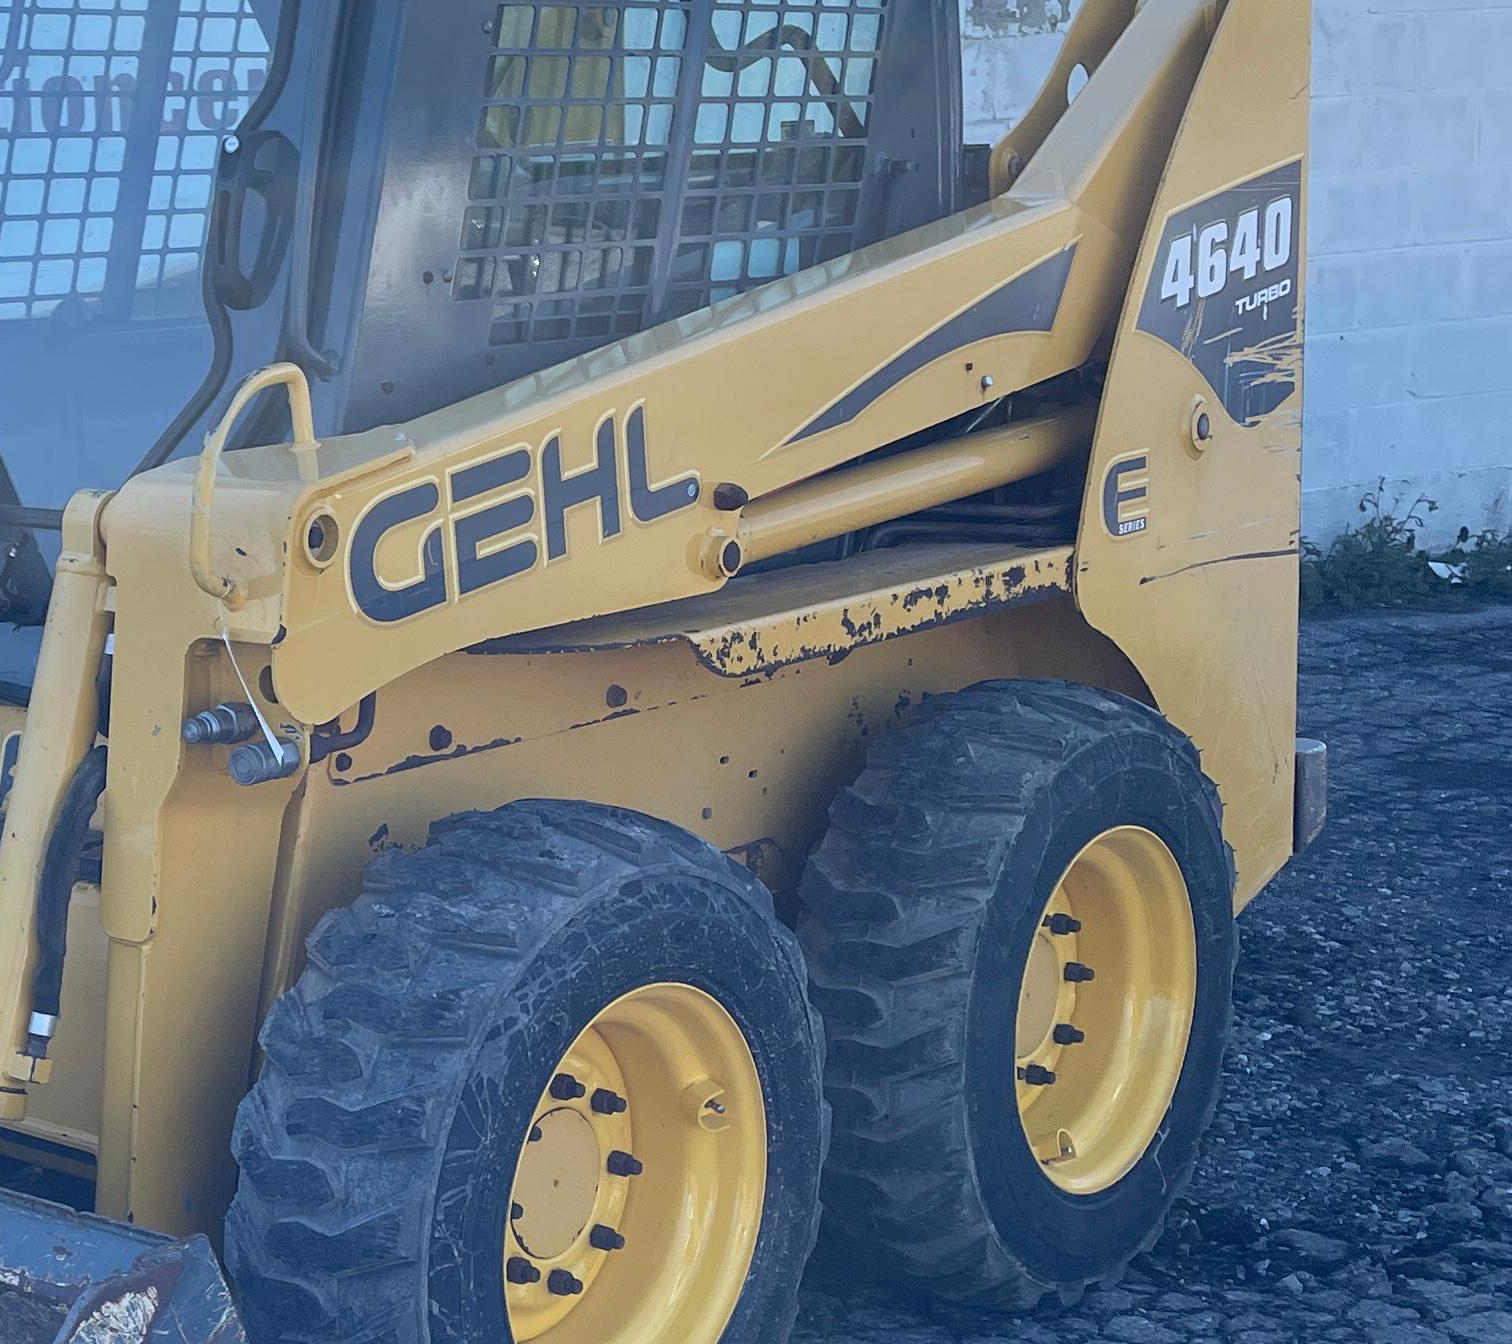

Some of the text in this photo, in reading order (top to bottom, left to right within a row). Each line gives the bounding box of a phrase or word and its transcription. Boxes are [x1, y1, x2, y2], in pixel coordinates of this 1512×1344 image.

[1159, 194, 1294, 309] 4640
[1235, 279, 1292, 317] TURBO
[345, 398, 700, 624] GEHL
[1118, 517, 1146, 537] SERIES
